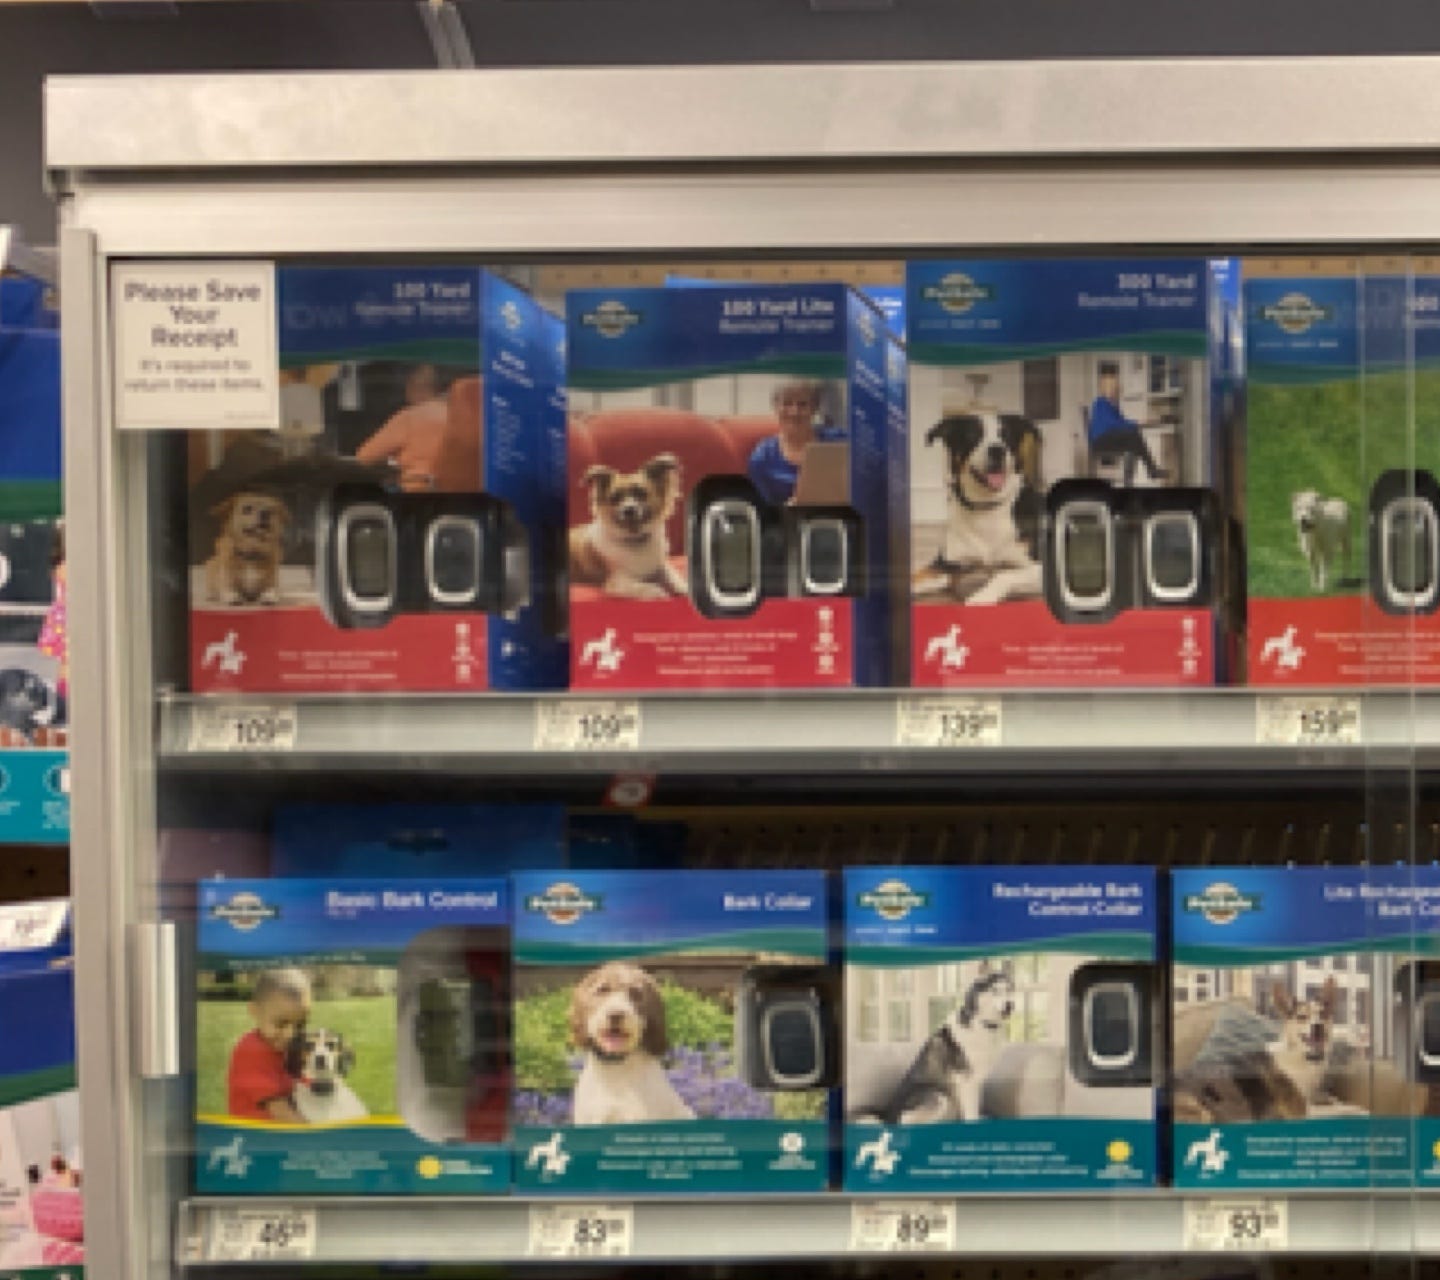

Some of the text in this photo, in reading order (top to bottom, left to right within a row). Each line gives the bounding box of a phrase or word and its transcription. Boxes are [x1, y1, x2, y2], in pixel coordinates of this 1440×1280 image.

[123, 279, 262, 302] Please Save
[431, 282, 471, 298] Yard
[169, 305, 220, 325] Your
[150, 327, 239, 351] Receipt
[327, 890, 498, 908] Basic Bark Control
[1106, 882, 1143, 898] Bark
[723, 891, 812, 911] Bark Collar
